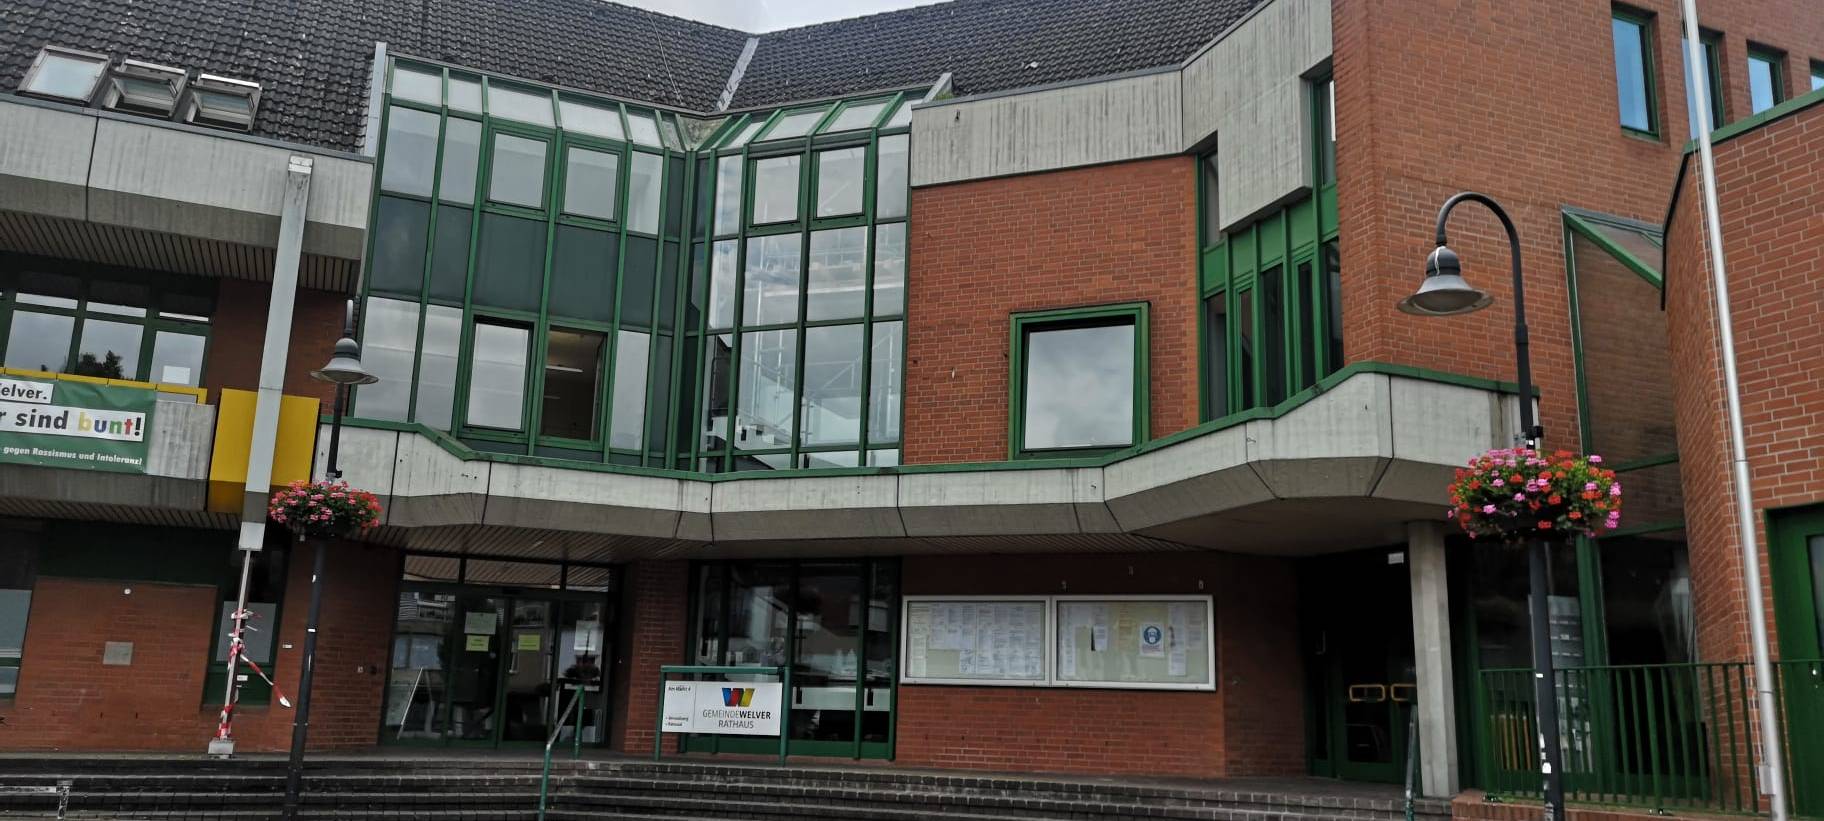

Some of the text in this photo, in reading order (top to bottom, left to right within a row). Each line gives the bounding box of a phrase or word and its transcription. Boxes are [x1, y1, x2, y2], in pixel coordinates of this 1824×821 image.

[0, 383, 48, 400] elver.
[15, 409, 69, 430] sind
[78, 411, 142, 436] bunt!
[3, 446, 143, 465] gegen Rassismus und Intoleranz!
[718, 719, 754, 729] RATHAUS
